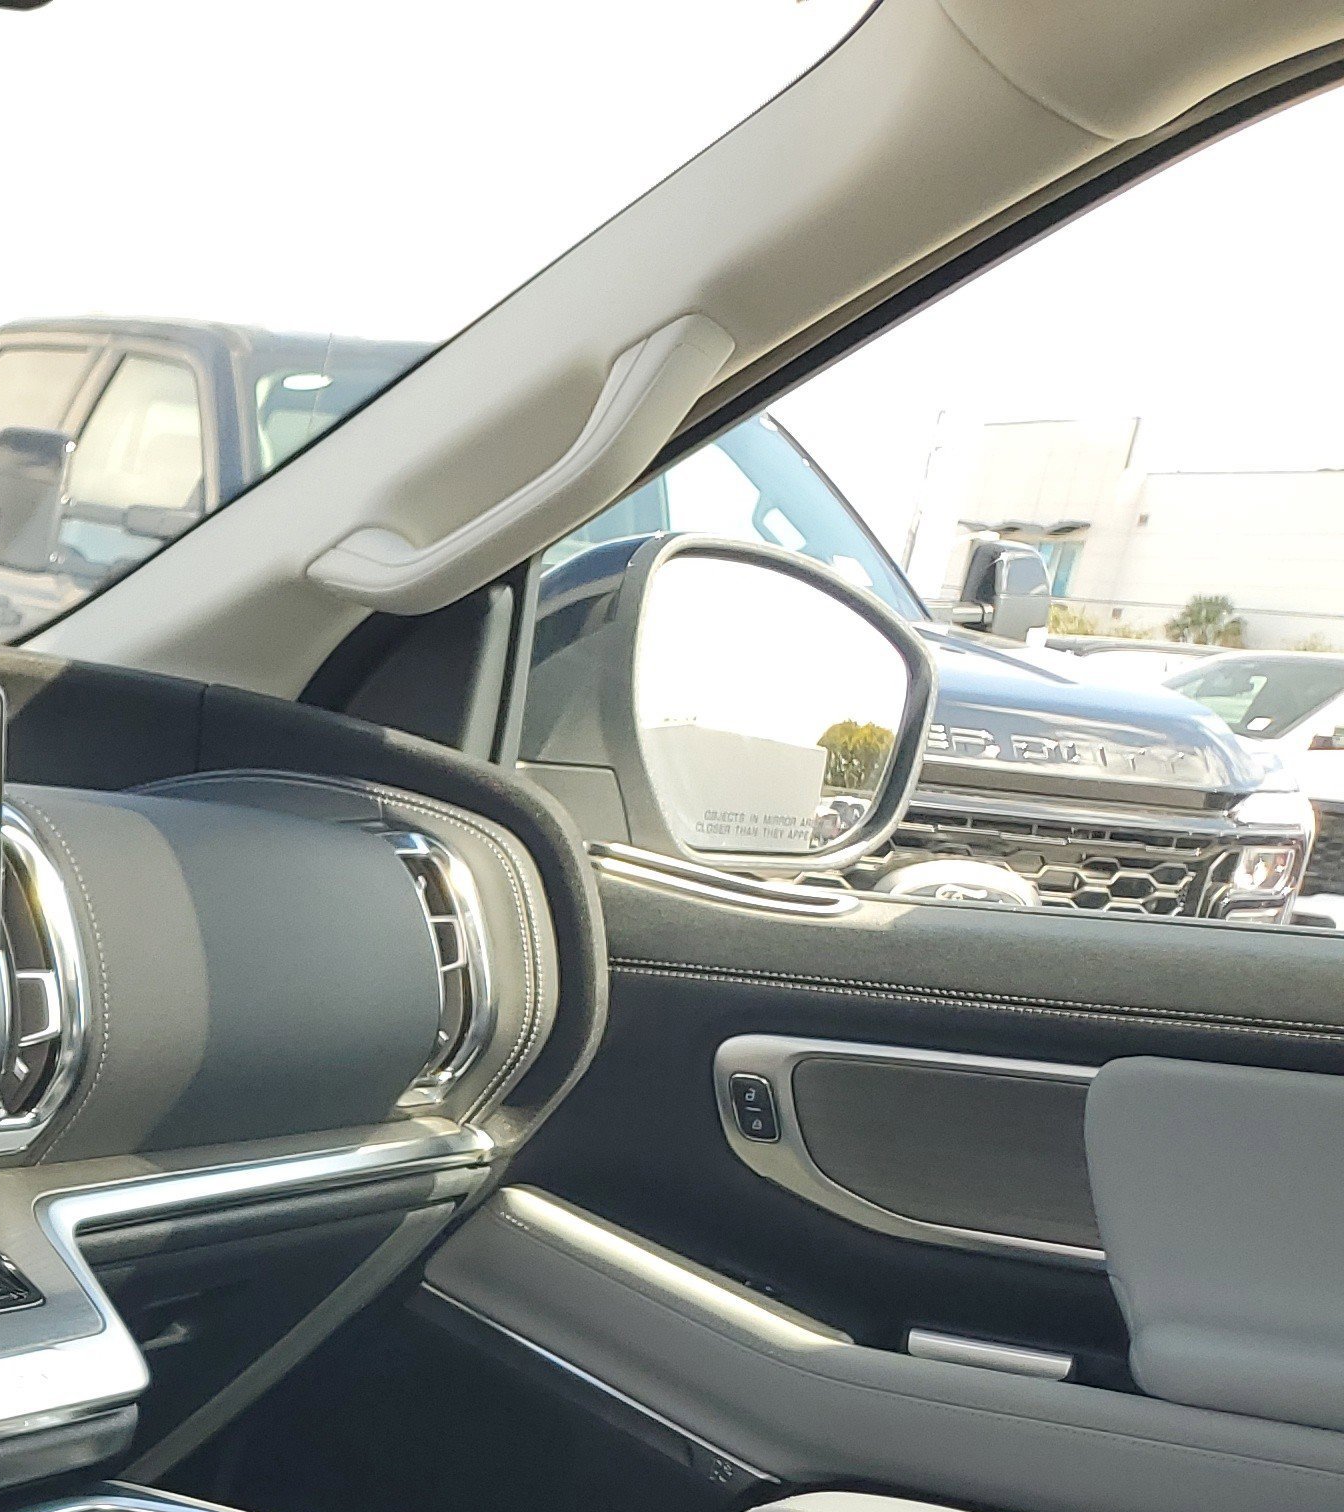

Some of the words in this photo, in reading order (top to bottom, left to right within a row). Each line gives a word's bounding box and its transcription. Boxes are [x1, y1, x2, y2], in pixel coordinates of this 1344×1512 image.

[704, 810, 745, 823] OBJECTS
[749, 814, 759, 824] IN
[763, 815, 797, 827] MIRROR
[696, 821, 731, 834] CLOSER
[735, 825, 759, 838] THAN
[763, 827, 784, 839] THEY
